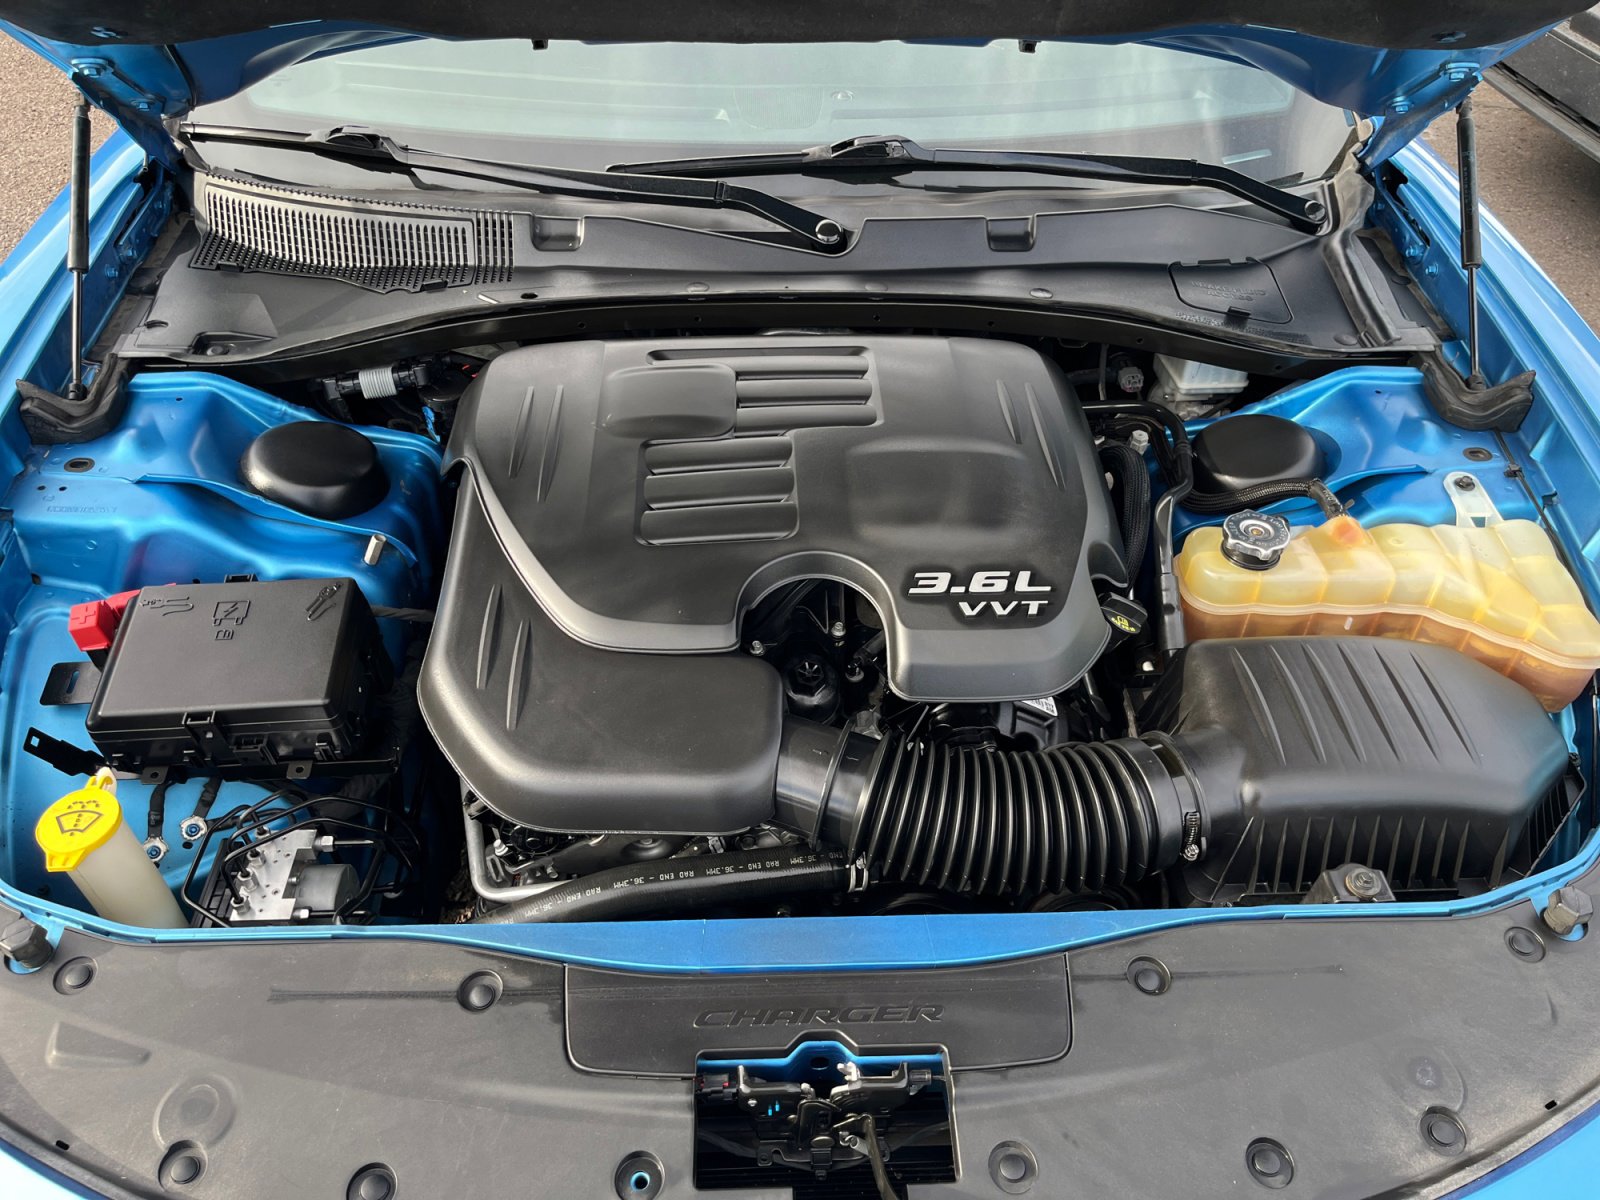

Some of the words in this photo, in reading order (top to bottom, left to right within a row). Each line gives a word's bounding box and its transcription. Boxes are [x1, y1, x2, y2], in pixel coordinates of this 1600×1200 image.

[908, 570, 1052, 596] 3.6L
[958, 600, 1049, 618] VVT
[766, 859, 780, 868] RAD
[790, 854, 817, 865] 36.3MM
[706, 865, 734, 875] 36.3MM
[748, 862, 762, 871] END
[659, 872, 675, 881] END
[679, 870, 694, 878] RAD
[613, 876, 645, 889] 36.3MM
[585, 886, 601, 897] RAD
[566, 892, 581, 903] END
[693, 1005, 944, 1028] CHARGER
